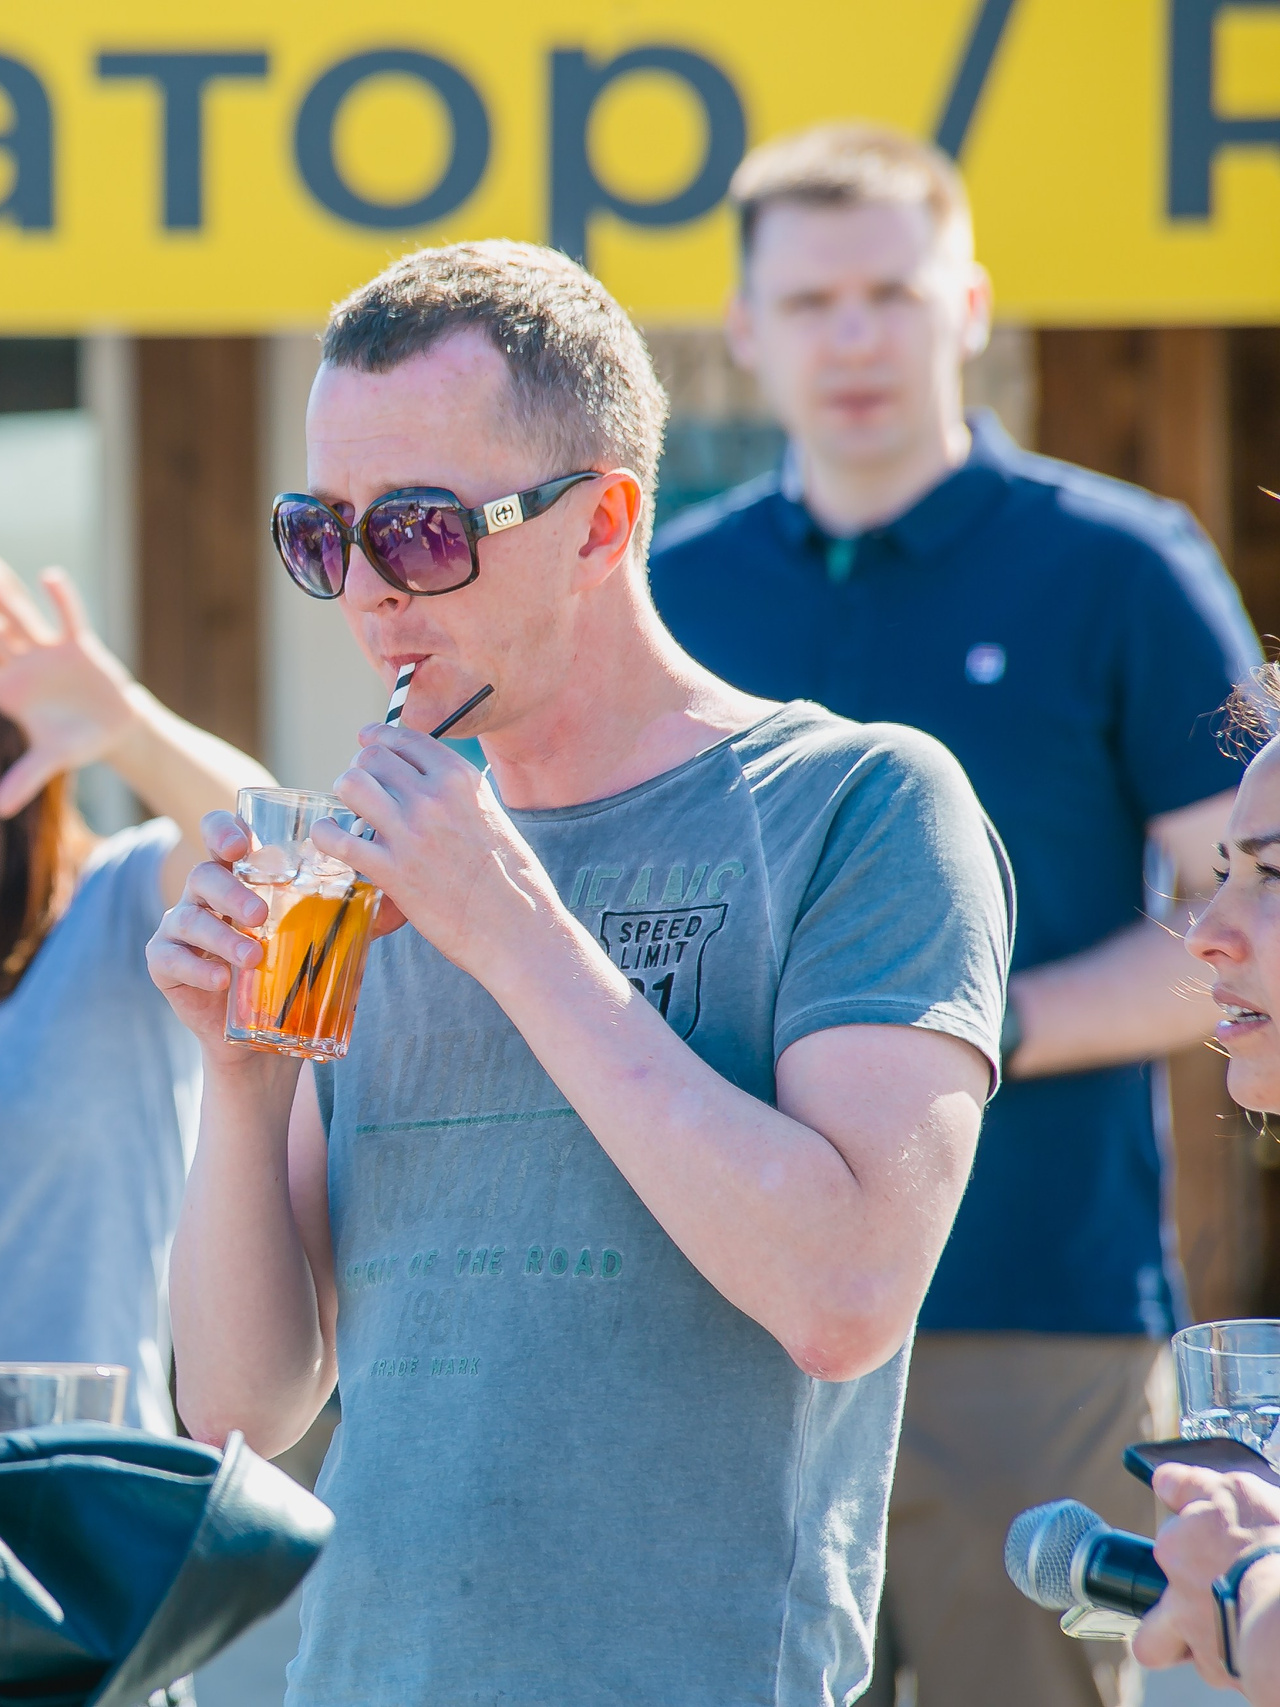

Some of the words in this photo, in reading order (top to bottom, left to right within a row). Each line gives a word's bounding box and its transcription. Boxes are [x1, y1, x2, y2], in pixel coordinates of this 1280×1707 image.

[619, 915, 703, 944] SPEED
[619, 941, 690, 970] LIMIT
[628, 972, 675, 1021] 1
[406, 1248, 440, 1279] OF
[454, 1246, 507, 1277] THE
[524, 1245, 624, 1279] ROAD
[370, 1355, 420, 1378] TRADE
[431, 1355, 481, 1377] MARK
